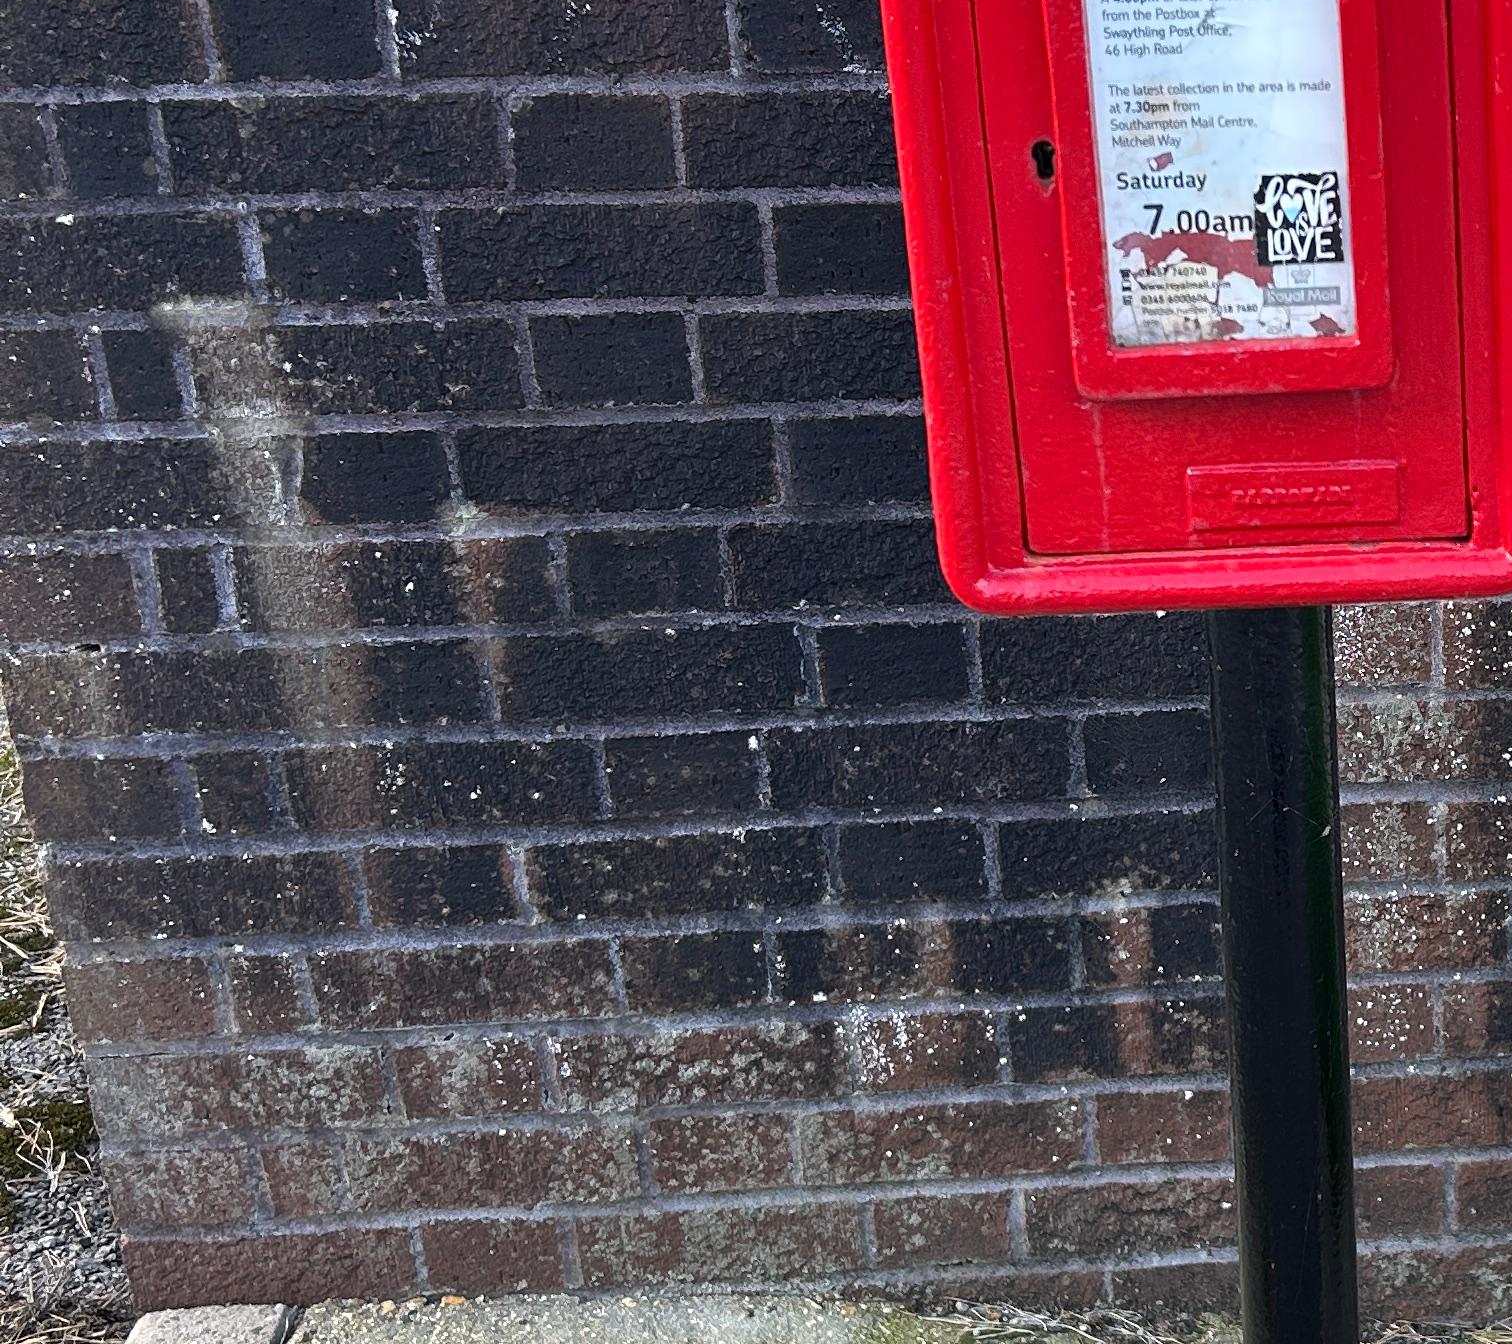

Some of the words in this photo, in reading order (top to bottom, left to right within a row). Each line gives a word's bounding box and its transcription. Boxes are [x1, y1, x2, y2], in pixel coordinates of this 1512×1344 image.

[1102, 8, 1129, 22] from
[1133, 7, 1152, 20] the
[1155, 6, 1200, 19] Postbox
[1104, 26, 1165, 41] Swaythling
[1169, 24, 1194, 38] Post
[1105, 44, 1120, 56] 46
[1124, 44, 1150, 58] High
[1154, 43, 1183, 55] Road
[1109, 84, 1130, 97] The
[1133, 83, 1164, 96] latest
[1168, 81, 1219, 95] collection
[1223, 81, 1234, 93] in
[1238, 81, 1255, 93] the
[1258, 81, 1283, 93] area
[1286, 80, 1296, 92] is
[1300, 80, 1331, 91] made
[1109, 103, 1121, 114] at
[1124, 101, 1170, 115] 7.30pm
[1173, 100, 1200, 112] from
[1110, 118, 1186, 133] Southampton
[1191, 117, 1215, 129] Mail
[1112, 135, 1155, 148] Mitchell
[1158, 134, 1181, 149] Way
[1117, 172, 1207, 192] Saturday
[1143, 204, 1252, 235] 7.00am
[1267, 226, 1335, 262] LOVE
